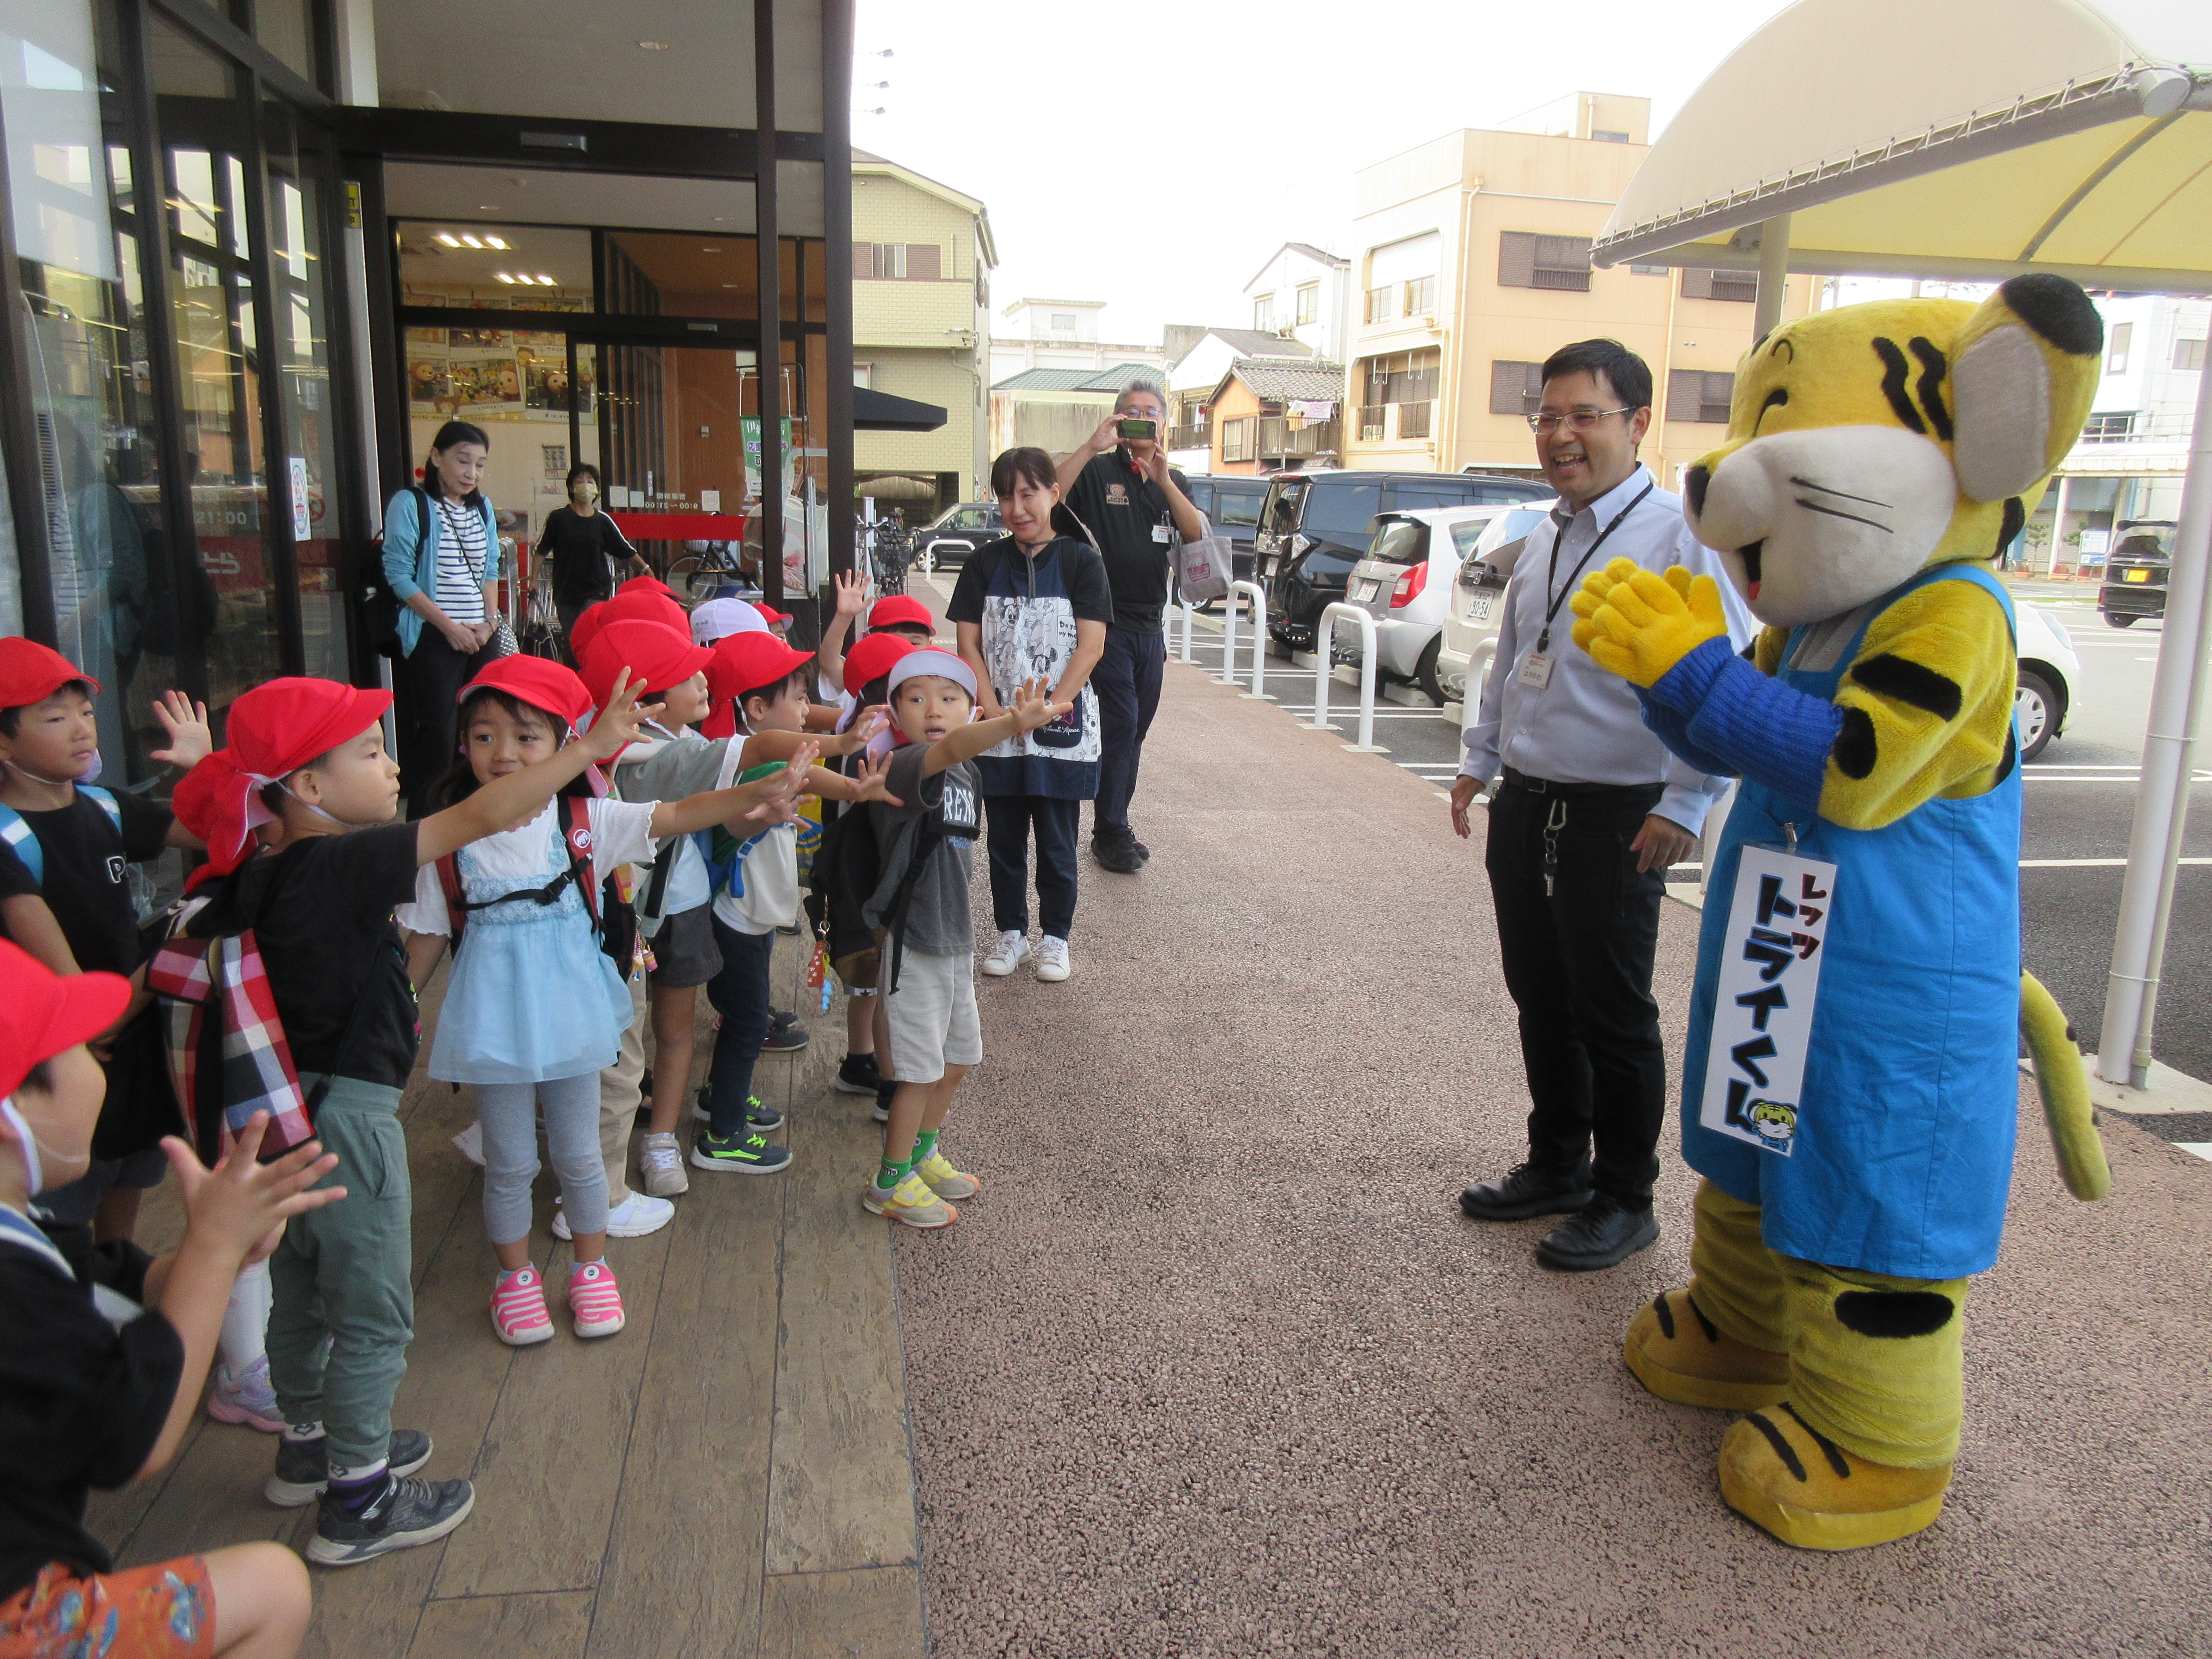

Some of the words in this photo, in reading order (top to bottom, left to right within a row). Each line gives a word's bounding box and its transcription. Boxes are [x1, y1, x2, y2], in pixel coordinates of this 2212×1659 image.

[1723, 873, 1798, 1135] トライくん
